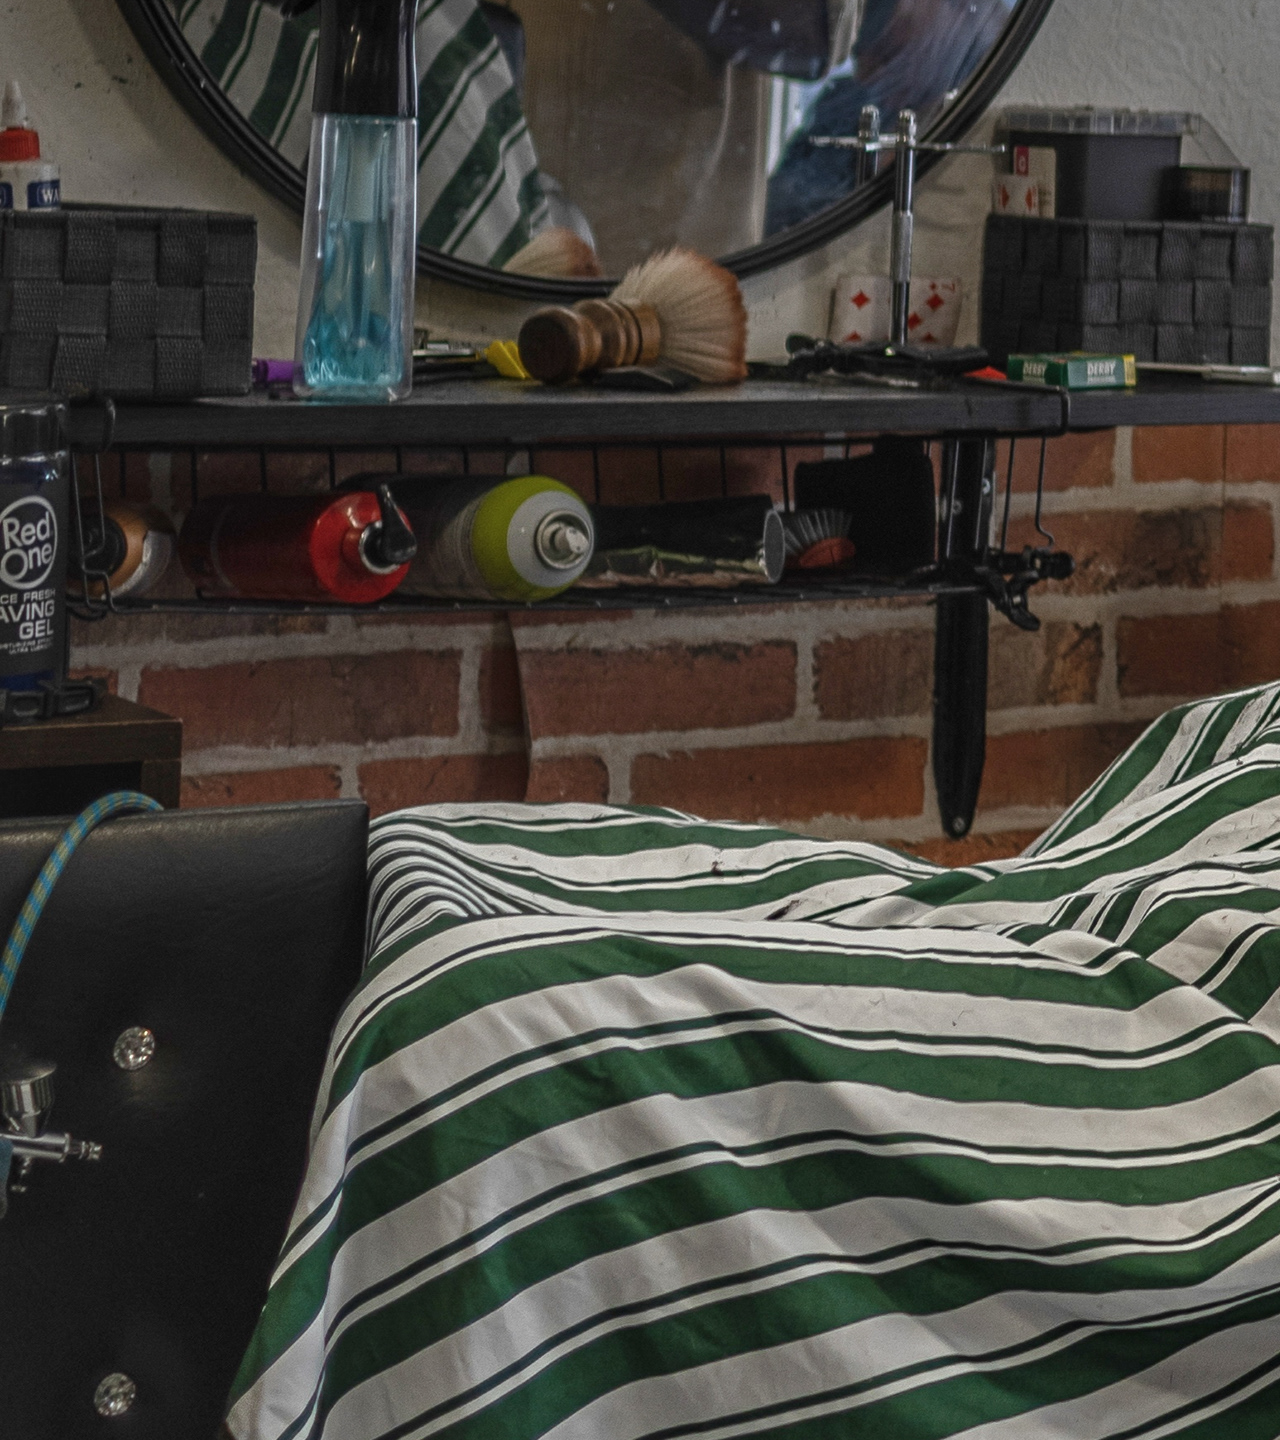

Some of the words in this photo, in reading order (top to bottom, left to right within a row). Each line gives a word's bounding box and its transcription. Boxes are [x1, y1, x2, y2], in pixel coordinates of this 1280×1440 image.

[1023, 361, 1048, 376] DERBY
[1087, 360, 1116, 376] DERBY
[2, 511, 51, 550] Red
[0, 543, 52, 581] One
[24, 588, 56, 603] FRESH
[19, 619, 55, 640] GEL
